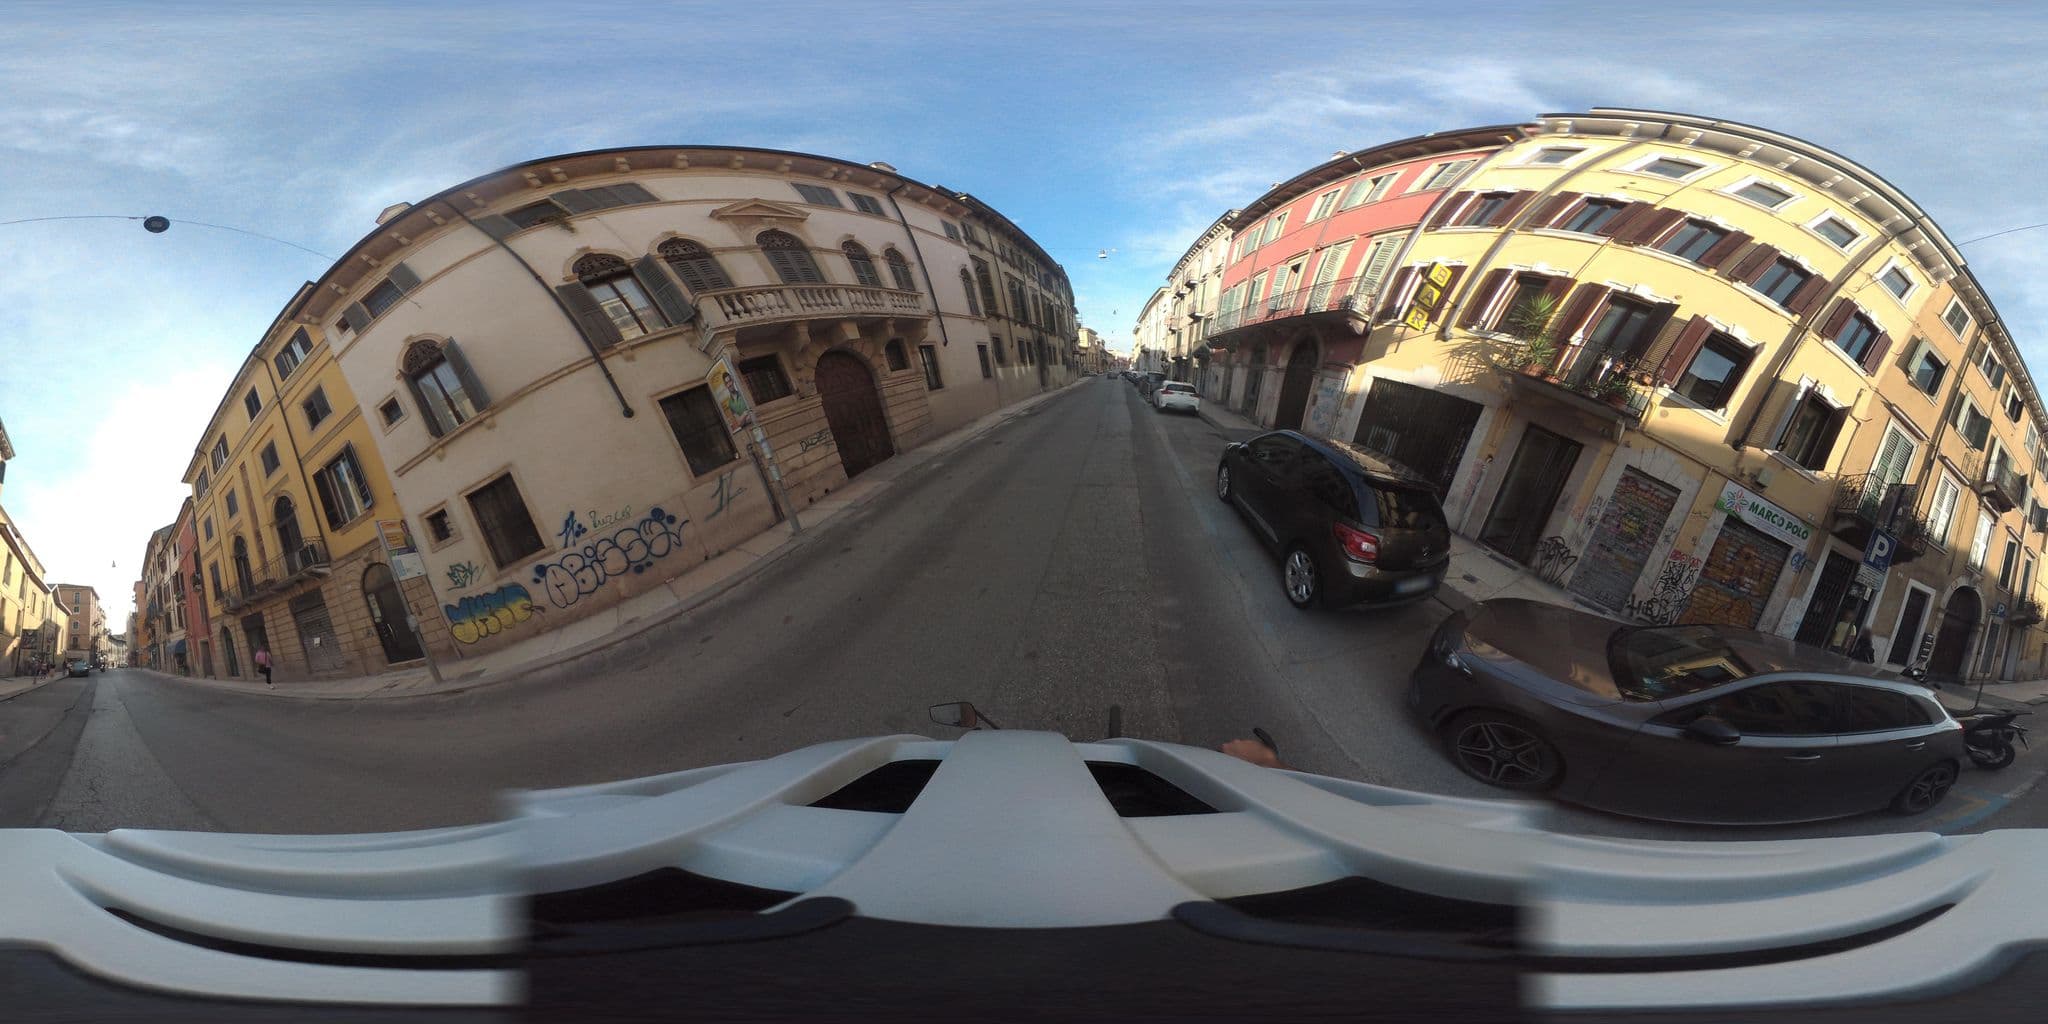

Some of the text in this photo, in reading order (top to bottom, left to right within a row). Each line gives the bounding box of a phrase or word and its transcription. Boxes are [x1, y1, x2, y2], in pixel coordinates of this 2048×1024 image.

[1410, 265, 1450, 330] BAR
[1748, 501, 1785, 527] MARCO
[1784, 521, 1810, 541] POLO
[1870, 535, 1890, 563] P
